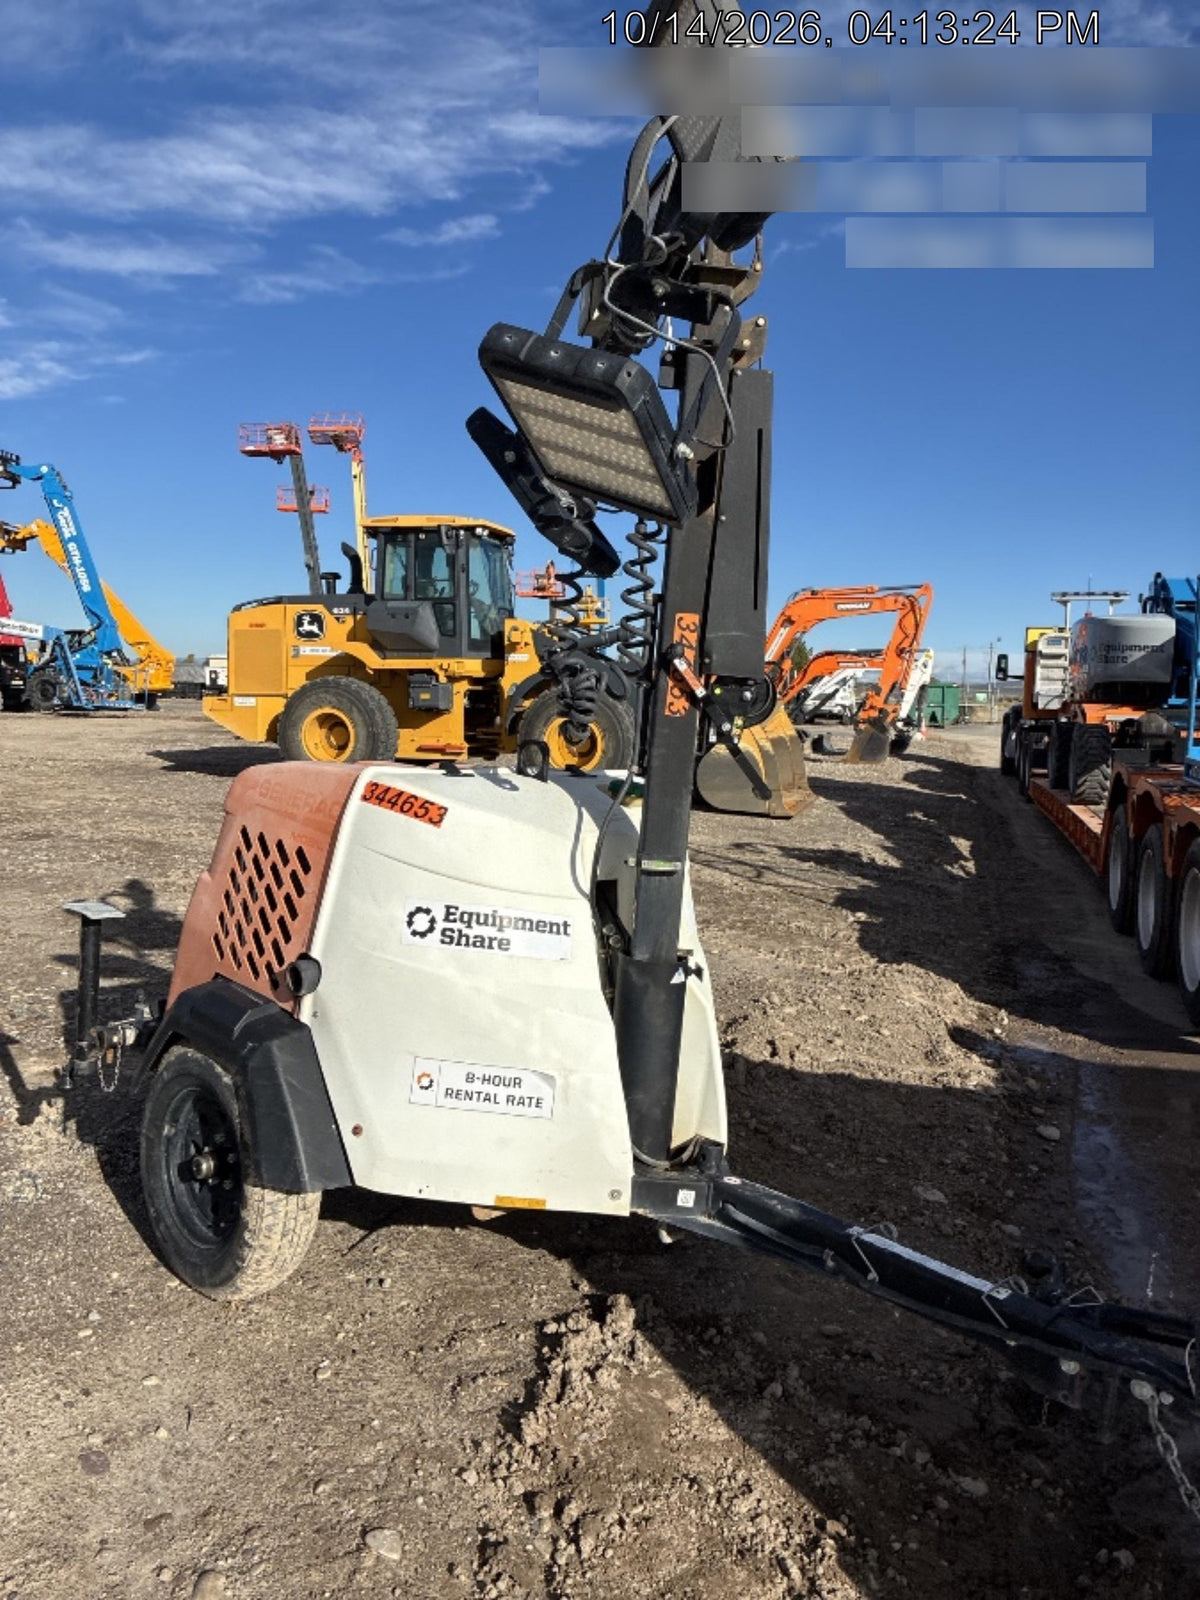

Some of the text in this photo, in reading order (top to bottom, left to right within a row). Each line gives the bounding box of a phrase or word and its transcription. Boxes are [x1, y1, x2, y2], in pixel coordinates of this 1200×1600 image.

[1098, 642, 1165, 654] Equipment
[363, 782, 449, 825] 344653
[442, 904, 571, 937] Equipment
[439, 927, 511, 951] Share
[465, 1071, 522, 1089] 8-HOUR
[444, 1087, 544, 1109] RENTAL RATE
